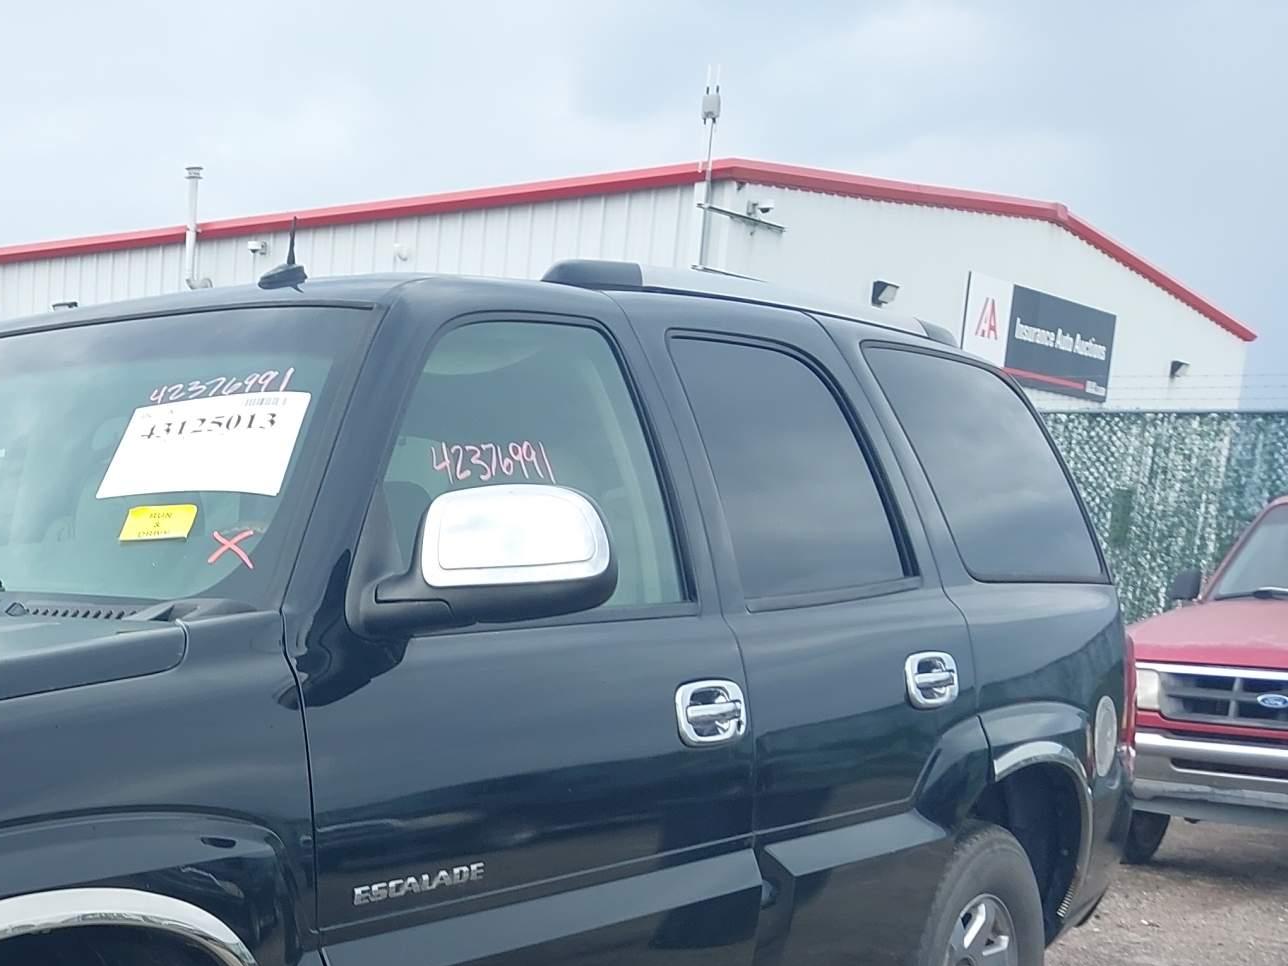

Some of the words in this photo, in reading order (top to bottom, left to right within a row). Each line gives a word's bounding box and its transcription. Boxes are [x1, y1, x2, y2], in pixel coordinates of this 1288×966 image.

[1054, 328, 1074, 353] Auto
[150, 367, 295, 404] 42376991
[140, 412, 278, 440] 43125013
[431, 441, 557, 485] 42376991
[353, 862, 485, 906] ESCALADE
